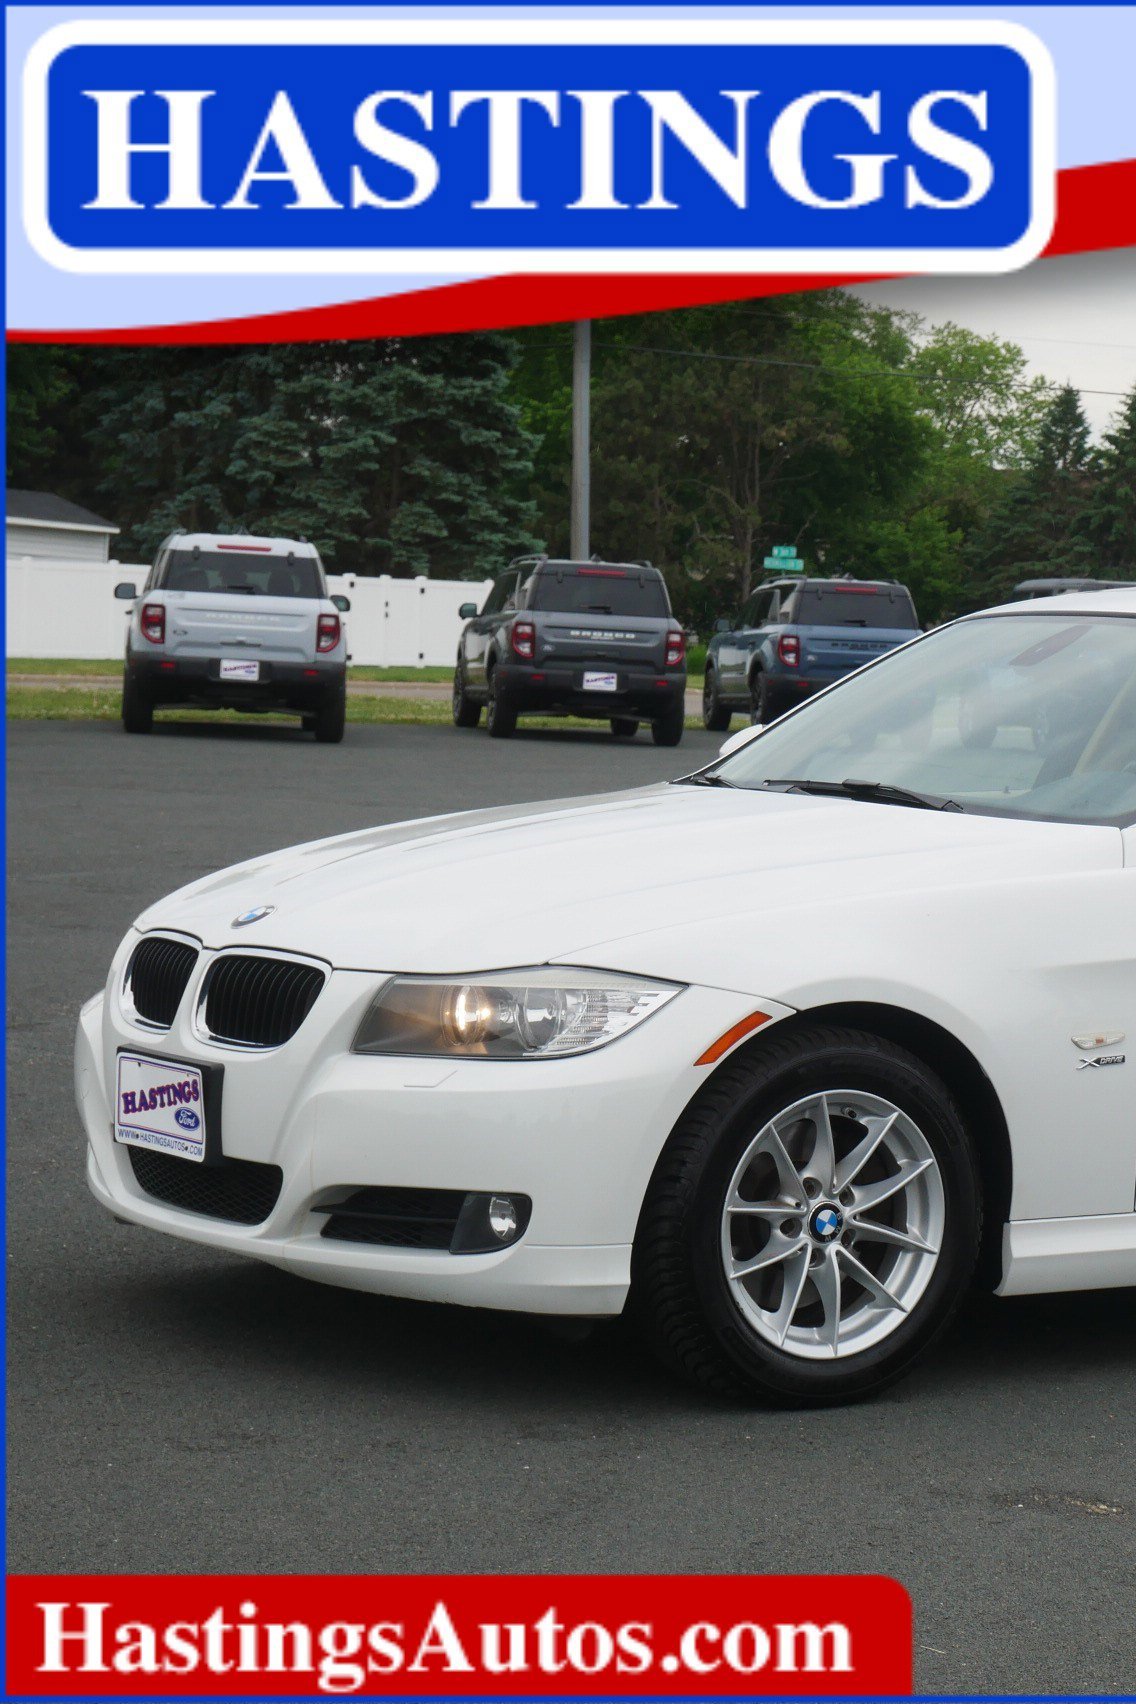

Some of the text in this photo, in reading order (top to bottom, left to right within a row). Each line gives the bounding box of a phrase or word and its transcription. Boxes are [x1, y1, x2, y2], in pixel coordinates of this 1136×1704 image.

[122, 1079, 199, 1114] HASTINGS
[179, 1110, 197, 1127] Ford
[118, 1128, 203, 1156] WWWHASTINGSAUTOS.COM
